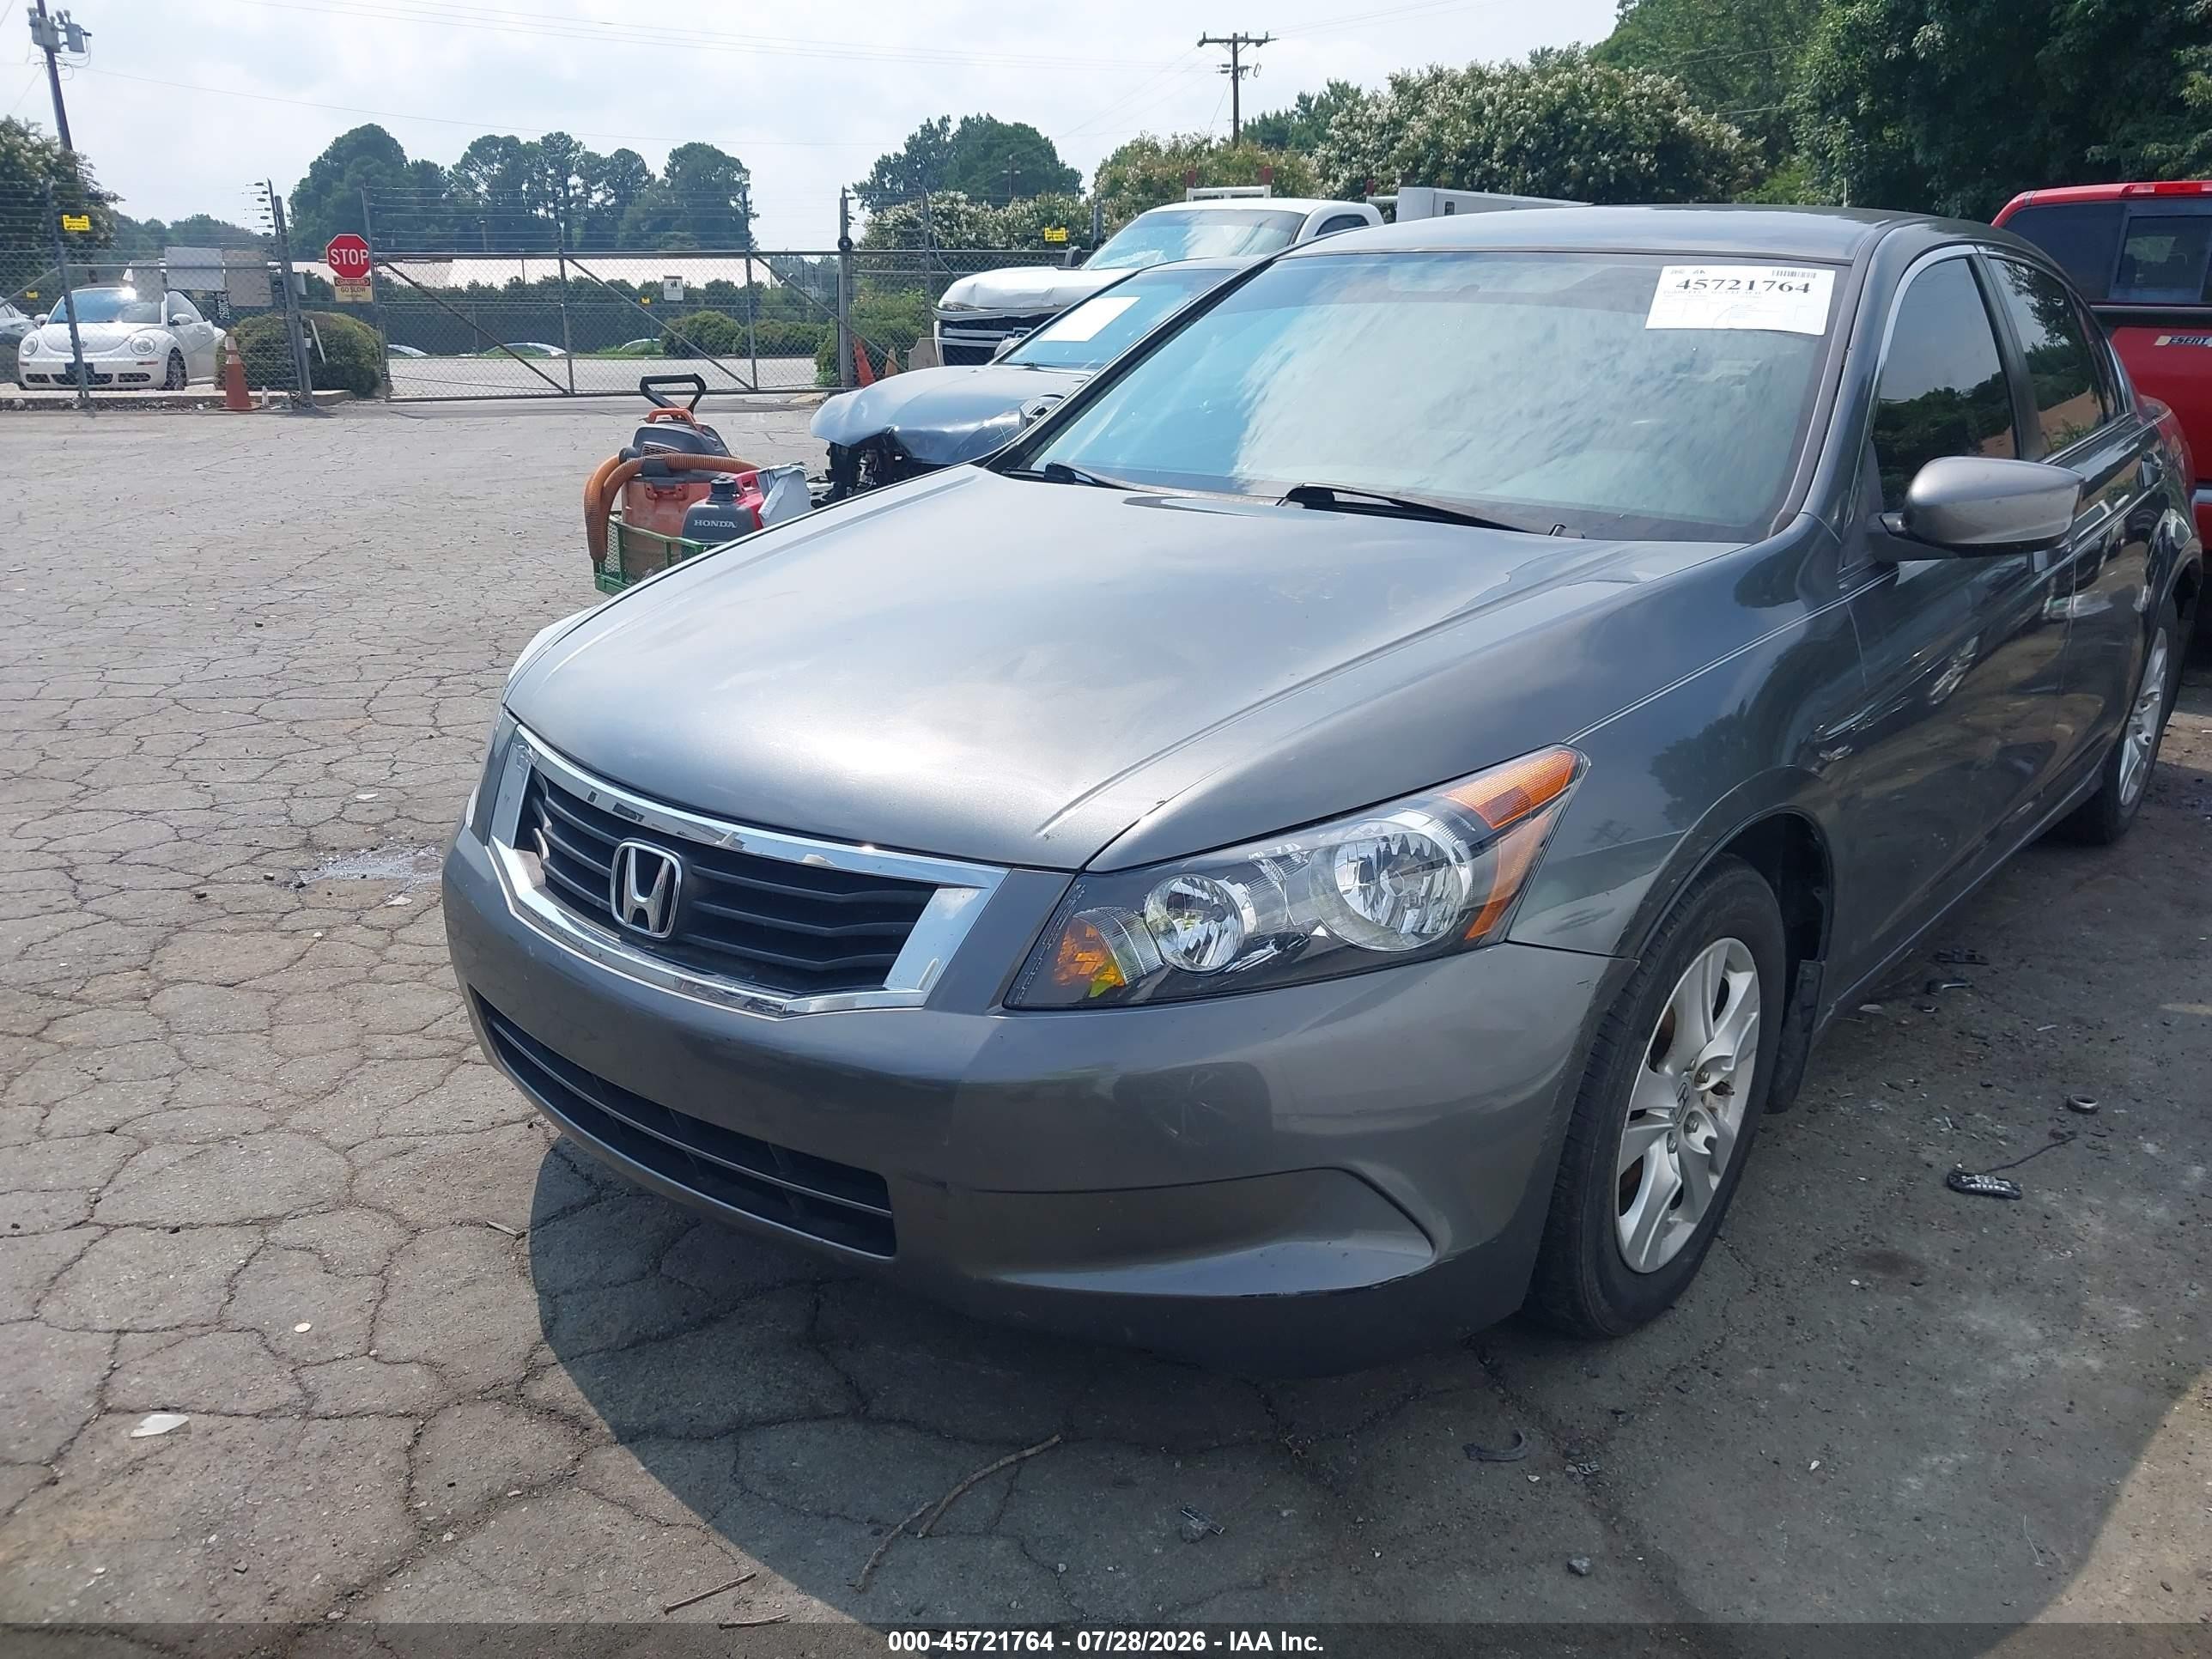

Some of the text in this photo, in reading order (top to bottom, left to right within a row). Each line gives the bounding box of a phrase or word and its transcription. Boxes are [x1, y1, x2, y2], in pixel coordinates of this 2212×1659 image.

[330, 248, 369, 265] STOP
[1675, 278, 1811, 294] 45721764
[693, 519, 738, 529] HONDA
